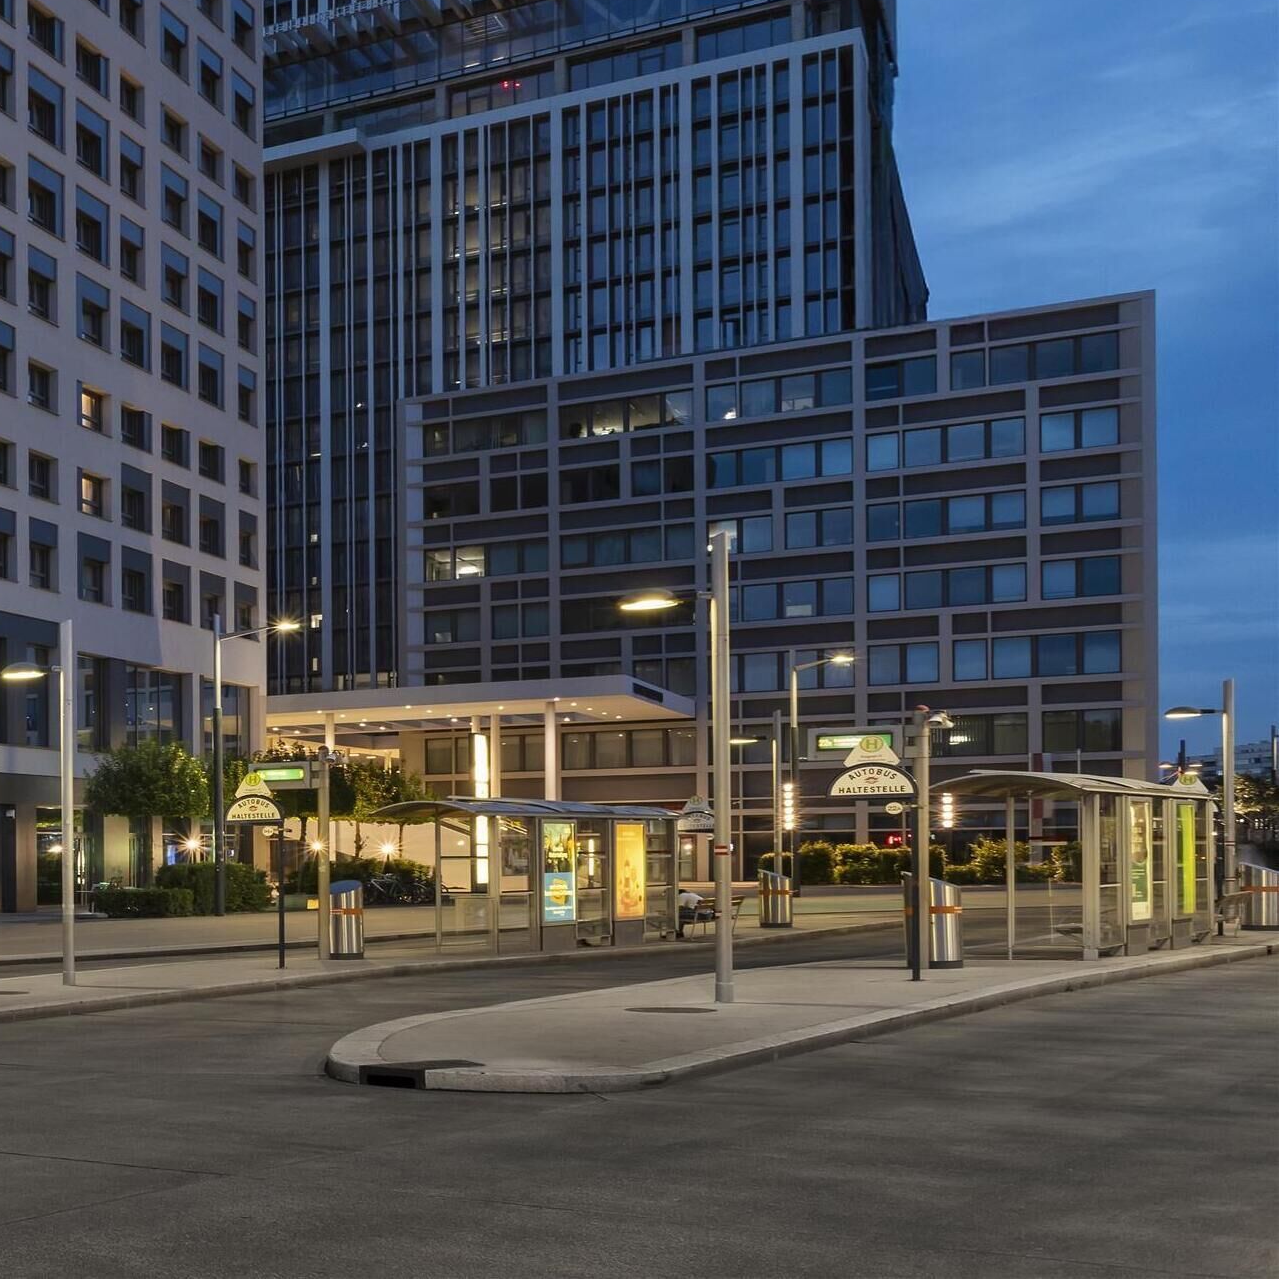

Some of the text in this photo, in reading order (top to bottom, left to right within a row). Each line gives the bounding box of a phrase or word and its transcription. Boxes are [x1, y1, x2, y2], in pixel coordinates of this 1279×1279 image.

[848, 768, 898, 781] AUTOBUS
[838, 784, 907, 794] HALTESTELLE
[237, 798, 270, 809] AUTOBUS
